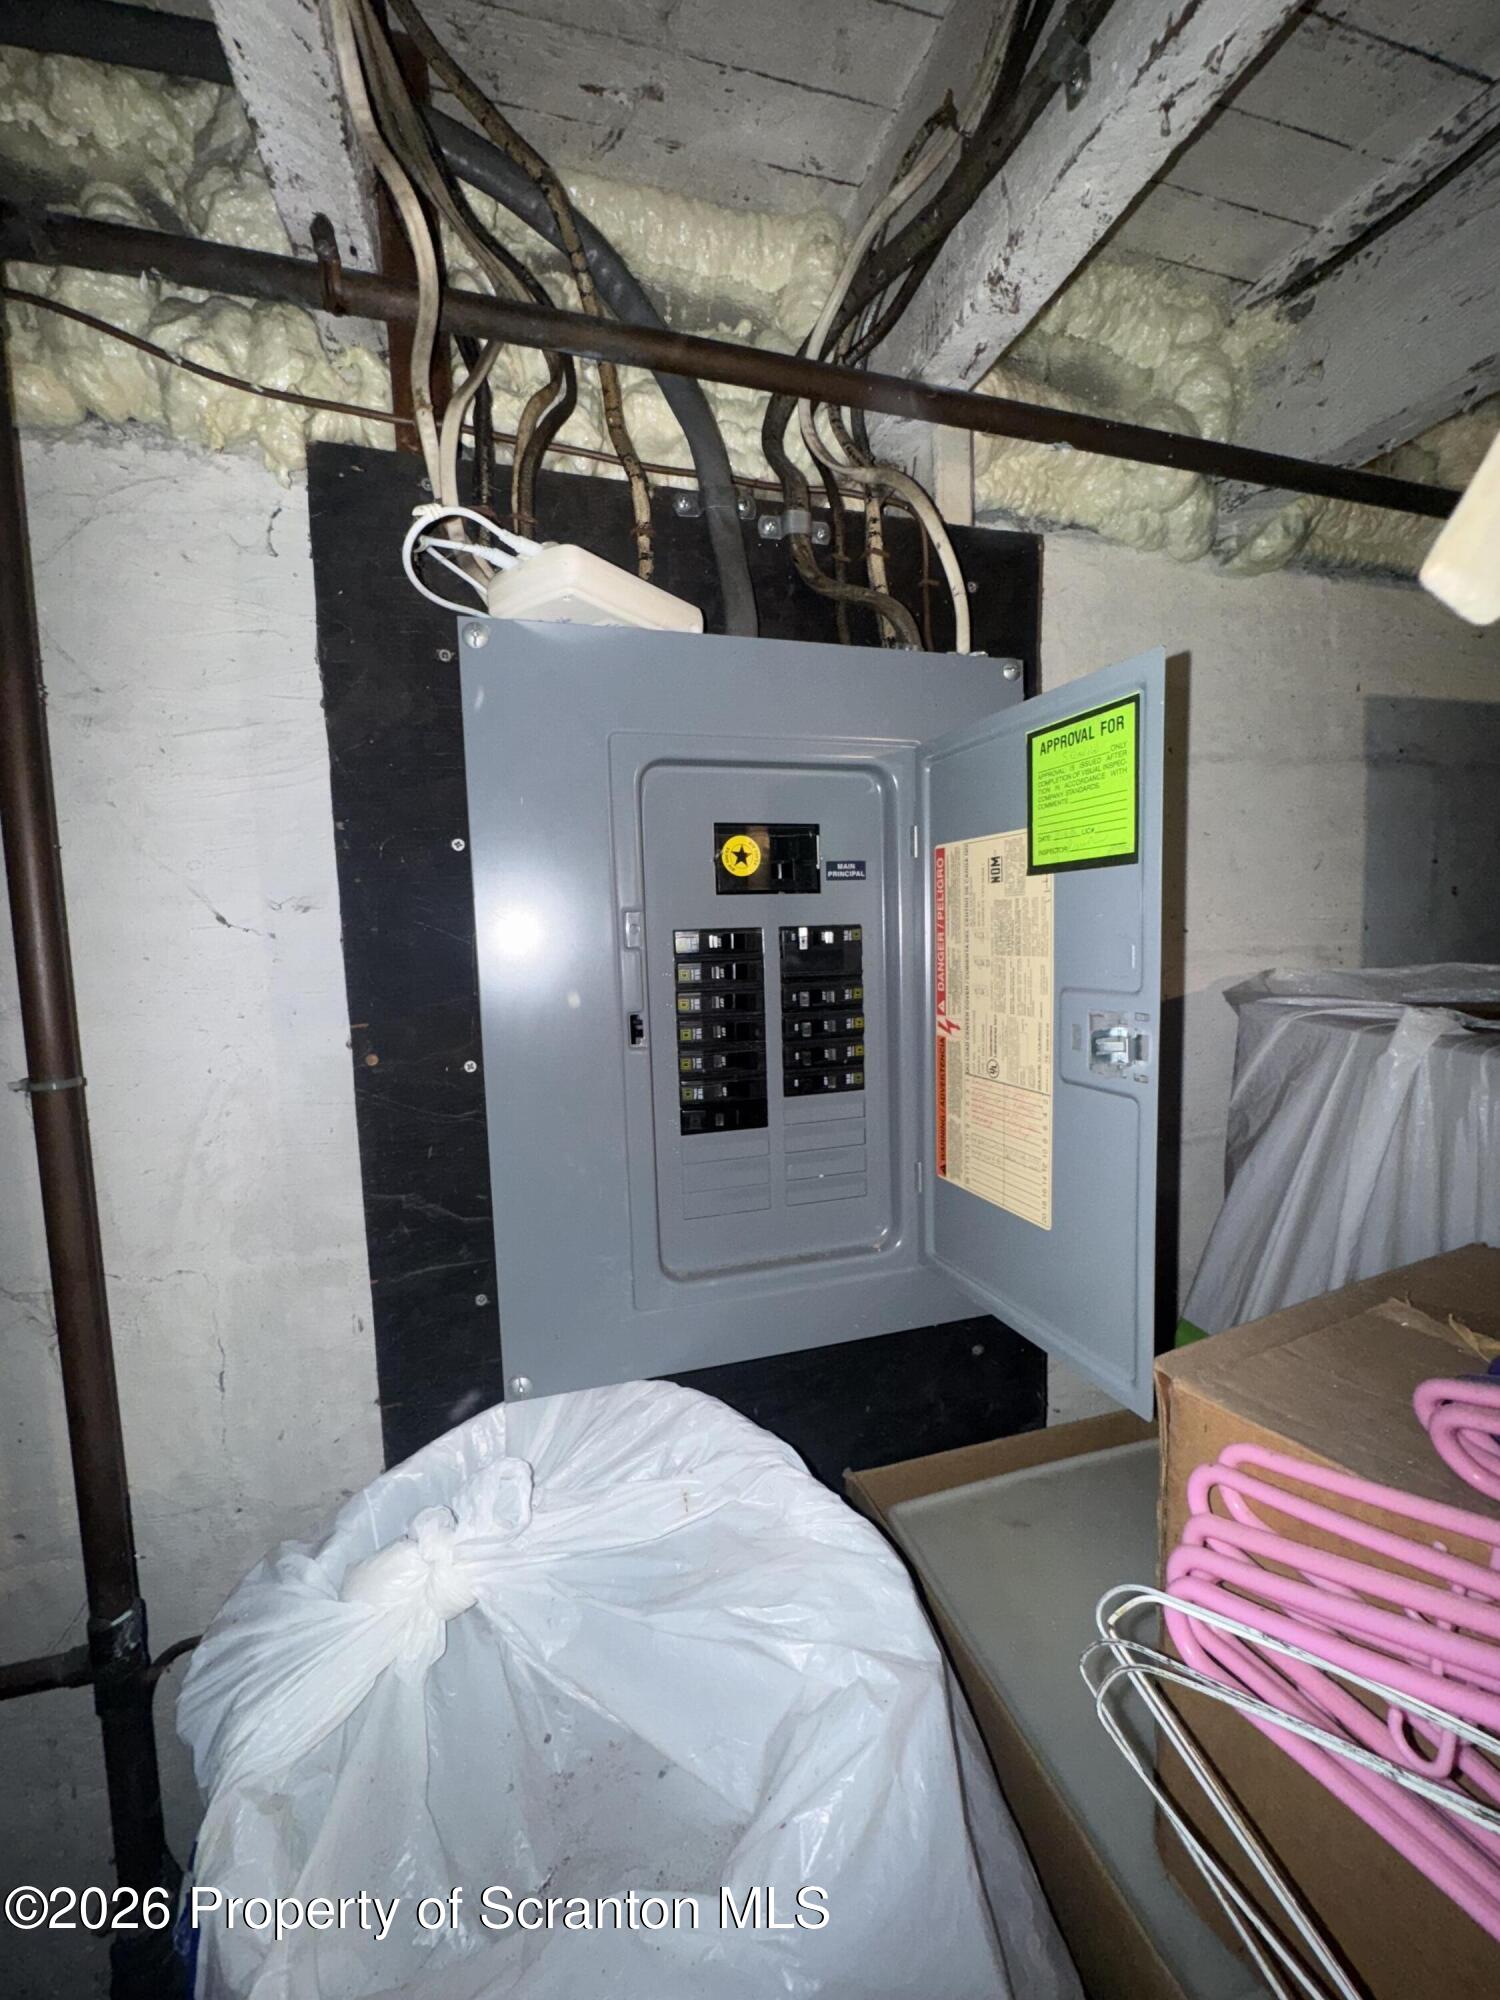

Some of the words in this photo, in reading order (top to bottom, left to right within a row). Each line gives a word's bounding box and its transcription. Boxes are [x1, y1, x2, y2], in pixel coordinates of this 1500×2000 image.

[1040, 726, 1094, 755] APPROVAL
[1100, 715, 1124, 736] FOR
[1106, 750, 1127, 760] AFTER
[1110, 767, 1127, 777] WITH
[990, 856, 1001, 884] NOM
[936, 857, 944, 919] PELIGRO
[937, 932, 945, 992] DANGER
